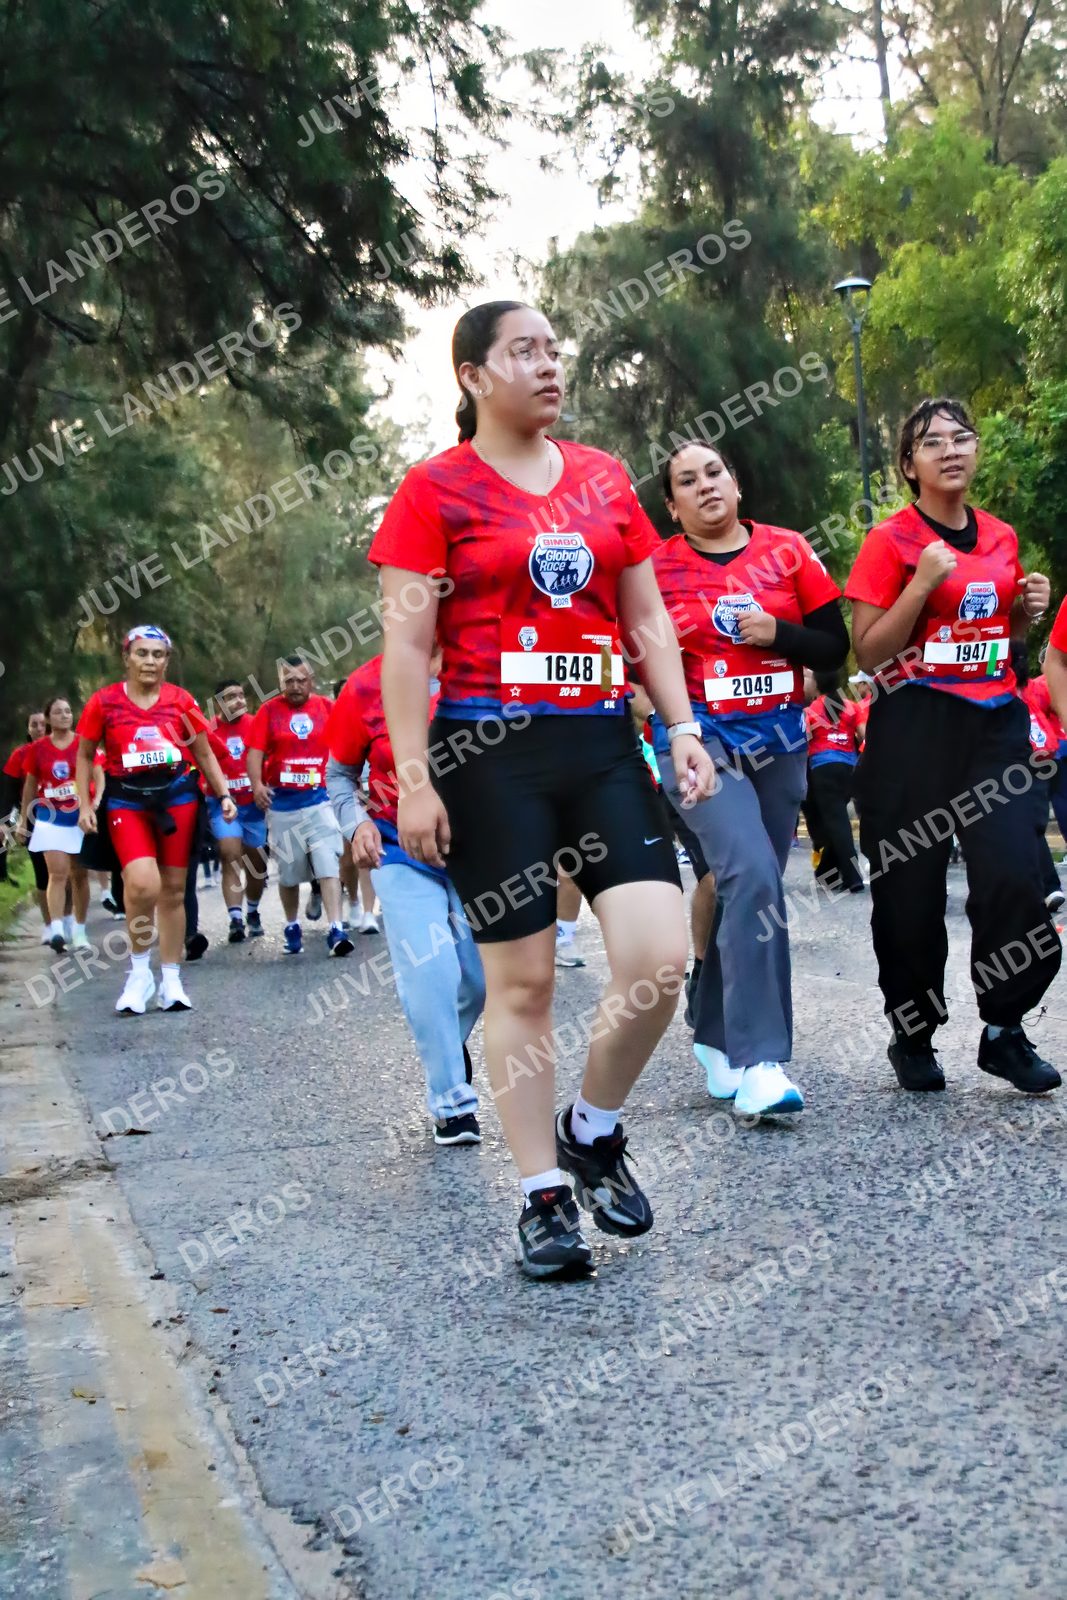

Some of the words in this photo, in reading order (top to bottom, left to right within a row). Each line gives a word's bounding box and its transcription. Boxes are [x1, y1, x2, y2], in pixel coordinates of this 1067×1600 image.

[546, 550, 579, 562] Global
[539, 561, 566, 571] Race
[956, 643, 987, 662] 1947
[545, 655, 593, 681] 1648
[559, 686, 581, 697] 20-26
[732, 675, 773, 697] 2049
[140, 751, 165, 765] 2646
